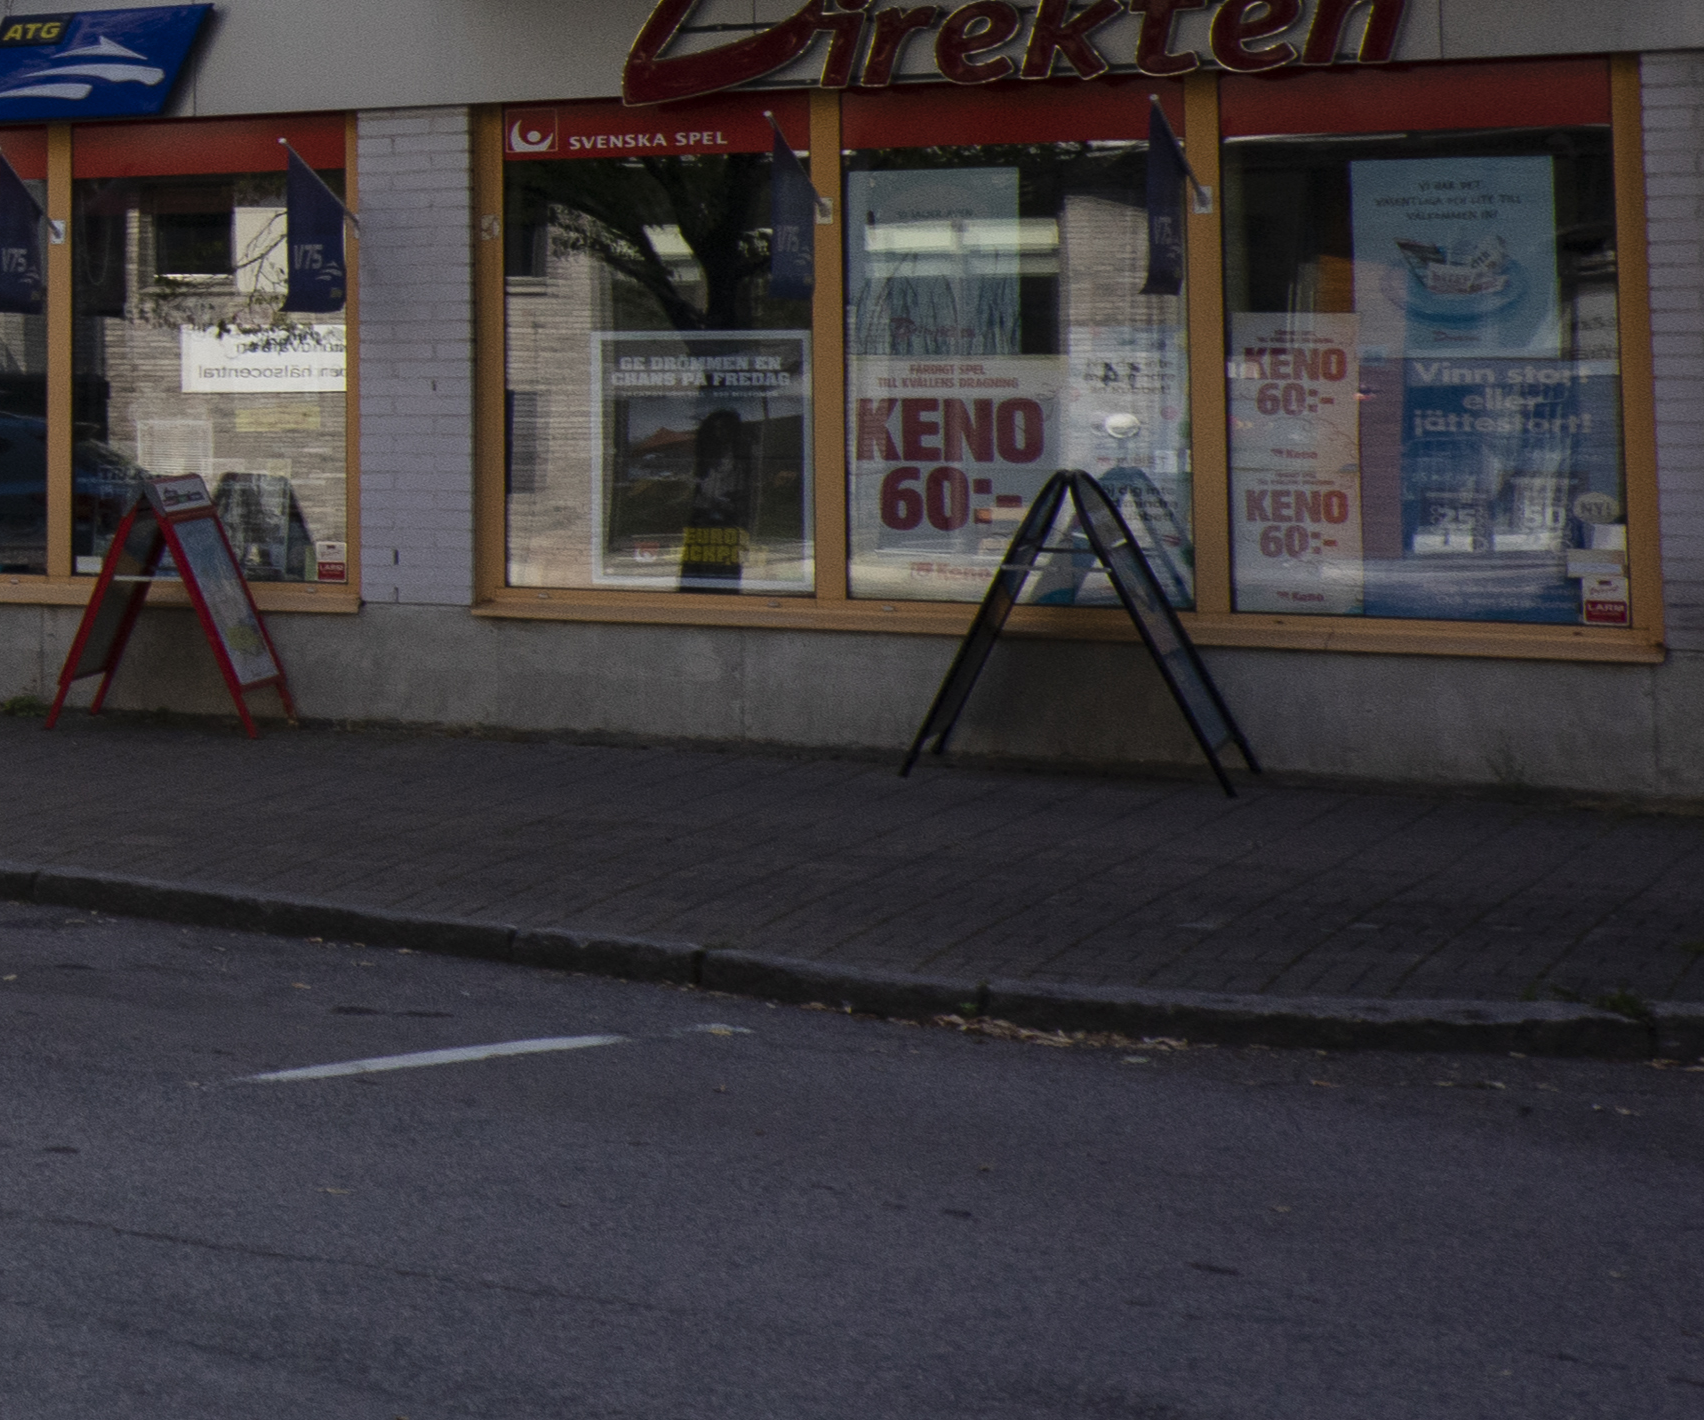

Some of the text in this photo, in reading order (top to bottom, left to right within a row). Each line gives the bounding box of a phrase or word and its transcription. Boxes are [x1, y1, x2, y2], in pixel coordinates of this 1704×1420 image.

[2, 22, 62, 41] ATG
[569, 131, 728, 150] SVENSKA SPEL
[1, 247, 28, 273] V75
[293, 244, 324, 270] V75
[620, 353, 782, 371] GE DRÖMMEN EN
[909, 363, 985, 376] FÄRDIGT SPEL
[1244, 347, 1347, 382] KENO
[1412, 362, 1588, 386] Vinn stort
[611, 370, 791, 386] CHANS PÅ FREDAG
[878, 375, 1019, 389] TILL KVÄLLENS DRAGNING
[1256, 382, 1335, 416] 60:-
[1462, 387, 1541, 411] eller
[855, 397, 1044, 464] KENO
[1414, 410, 1591, 437] jättestort!
[880, 466, 1022, 532] 60:-
[1245, 489, 1348, 524] KENO
[1259, 524, 1338, 558] 60:-
[1587, 603, 1625, 612] LARM
